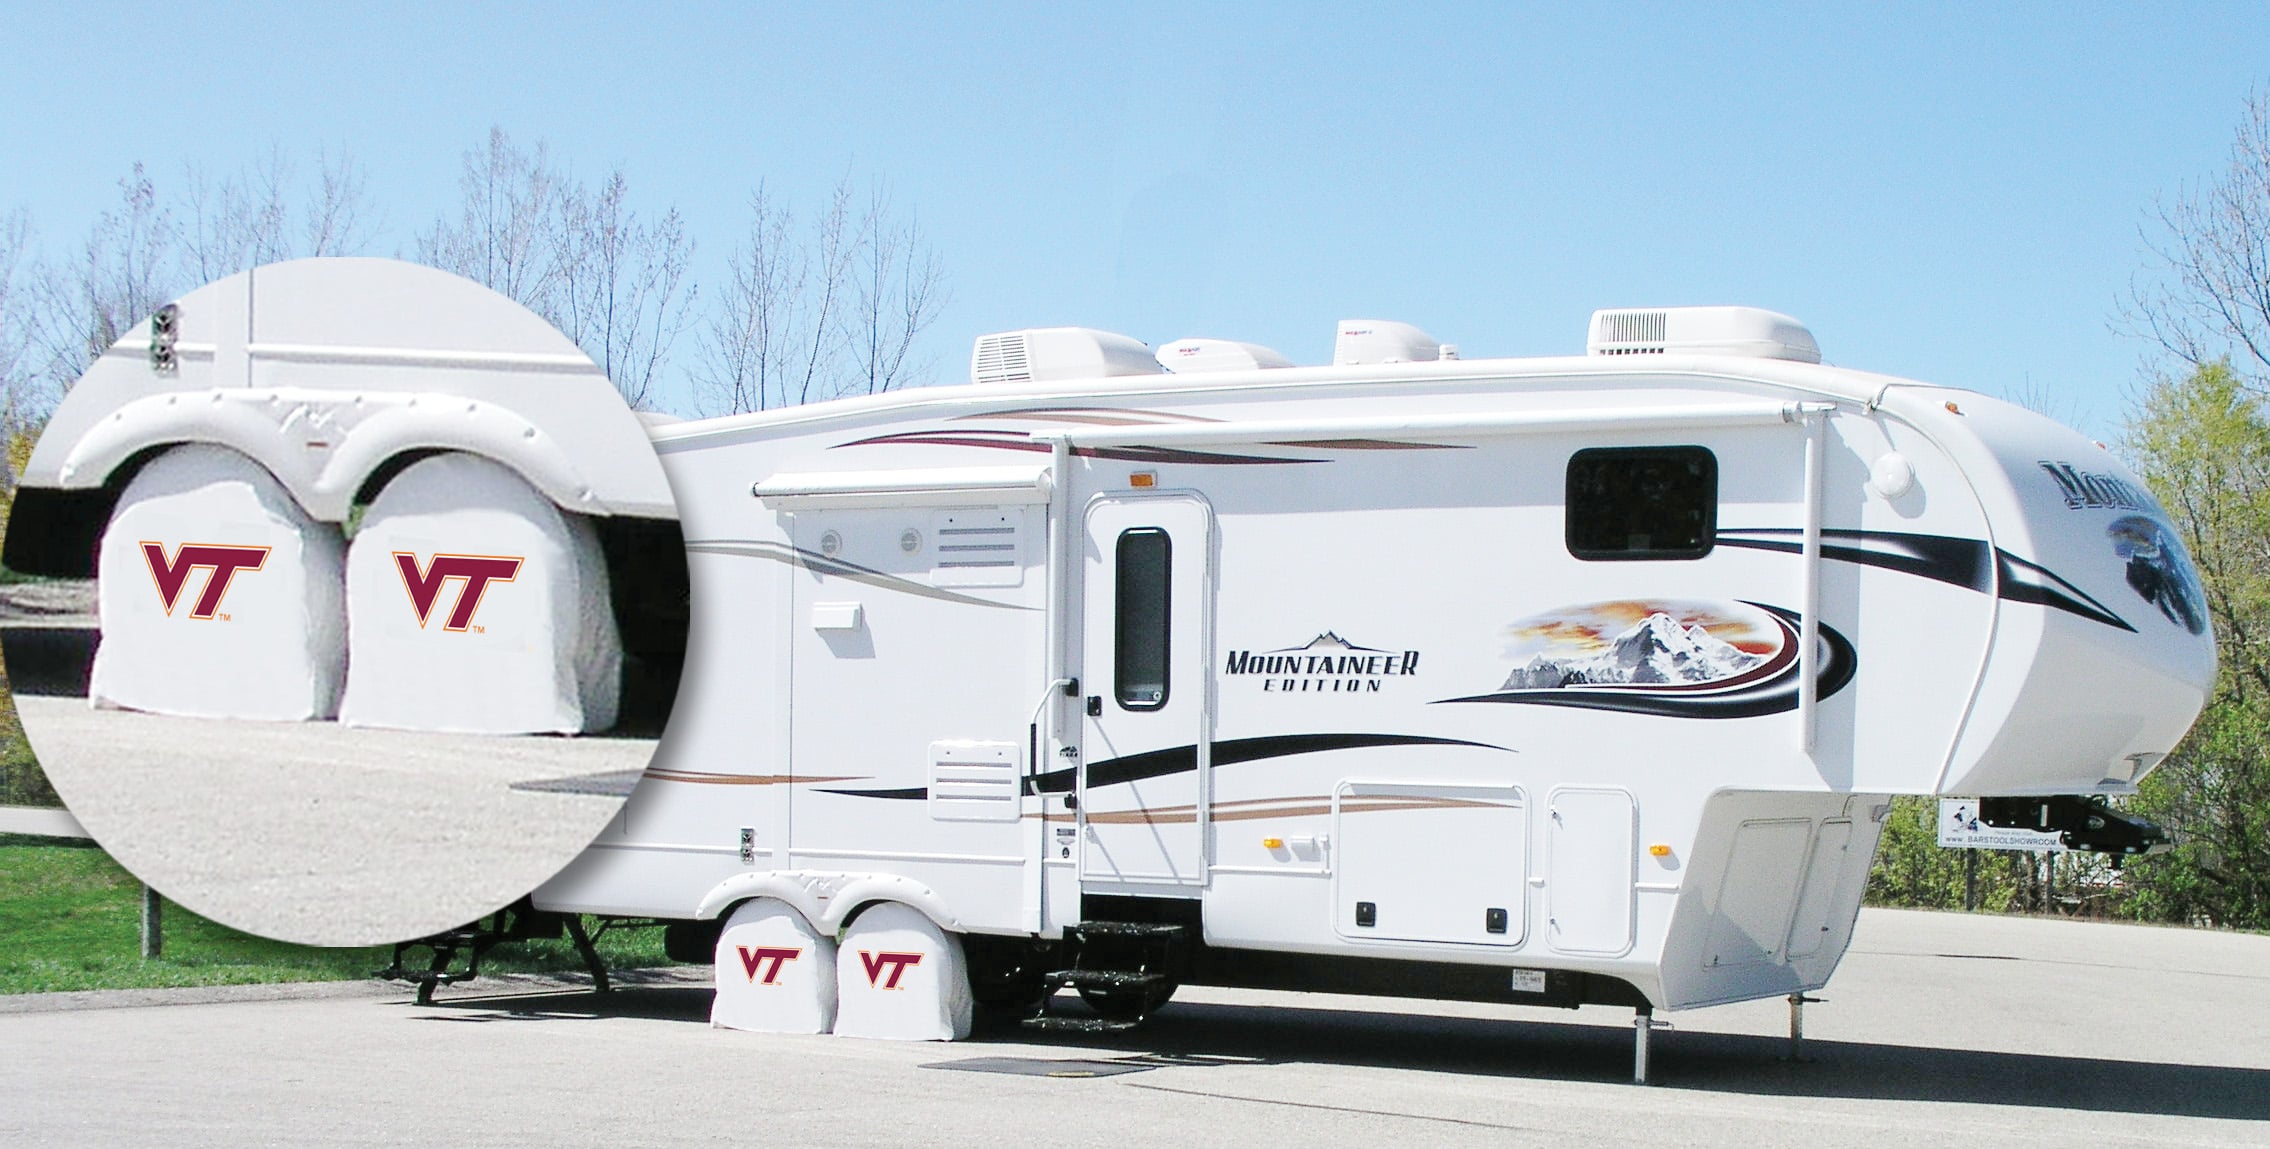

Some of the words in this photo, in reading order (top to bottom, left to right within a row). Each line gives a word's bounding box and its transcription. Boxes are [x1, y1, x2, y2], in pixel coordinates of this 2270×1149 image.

[139, 541, 272, 619] VT
[392, 551, 525, 632] VT
[1226, 651, 1419, 675] MOUNTAINEER
[1264, 679, 1381, 692] EDITION
[736, 945, 802, 986] VT
[858, 950, 925, 990] VT
